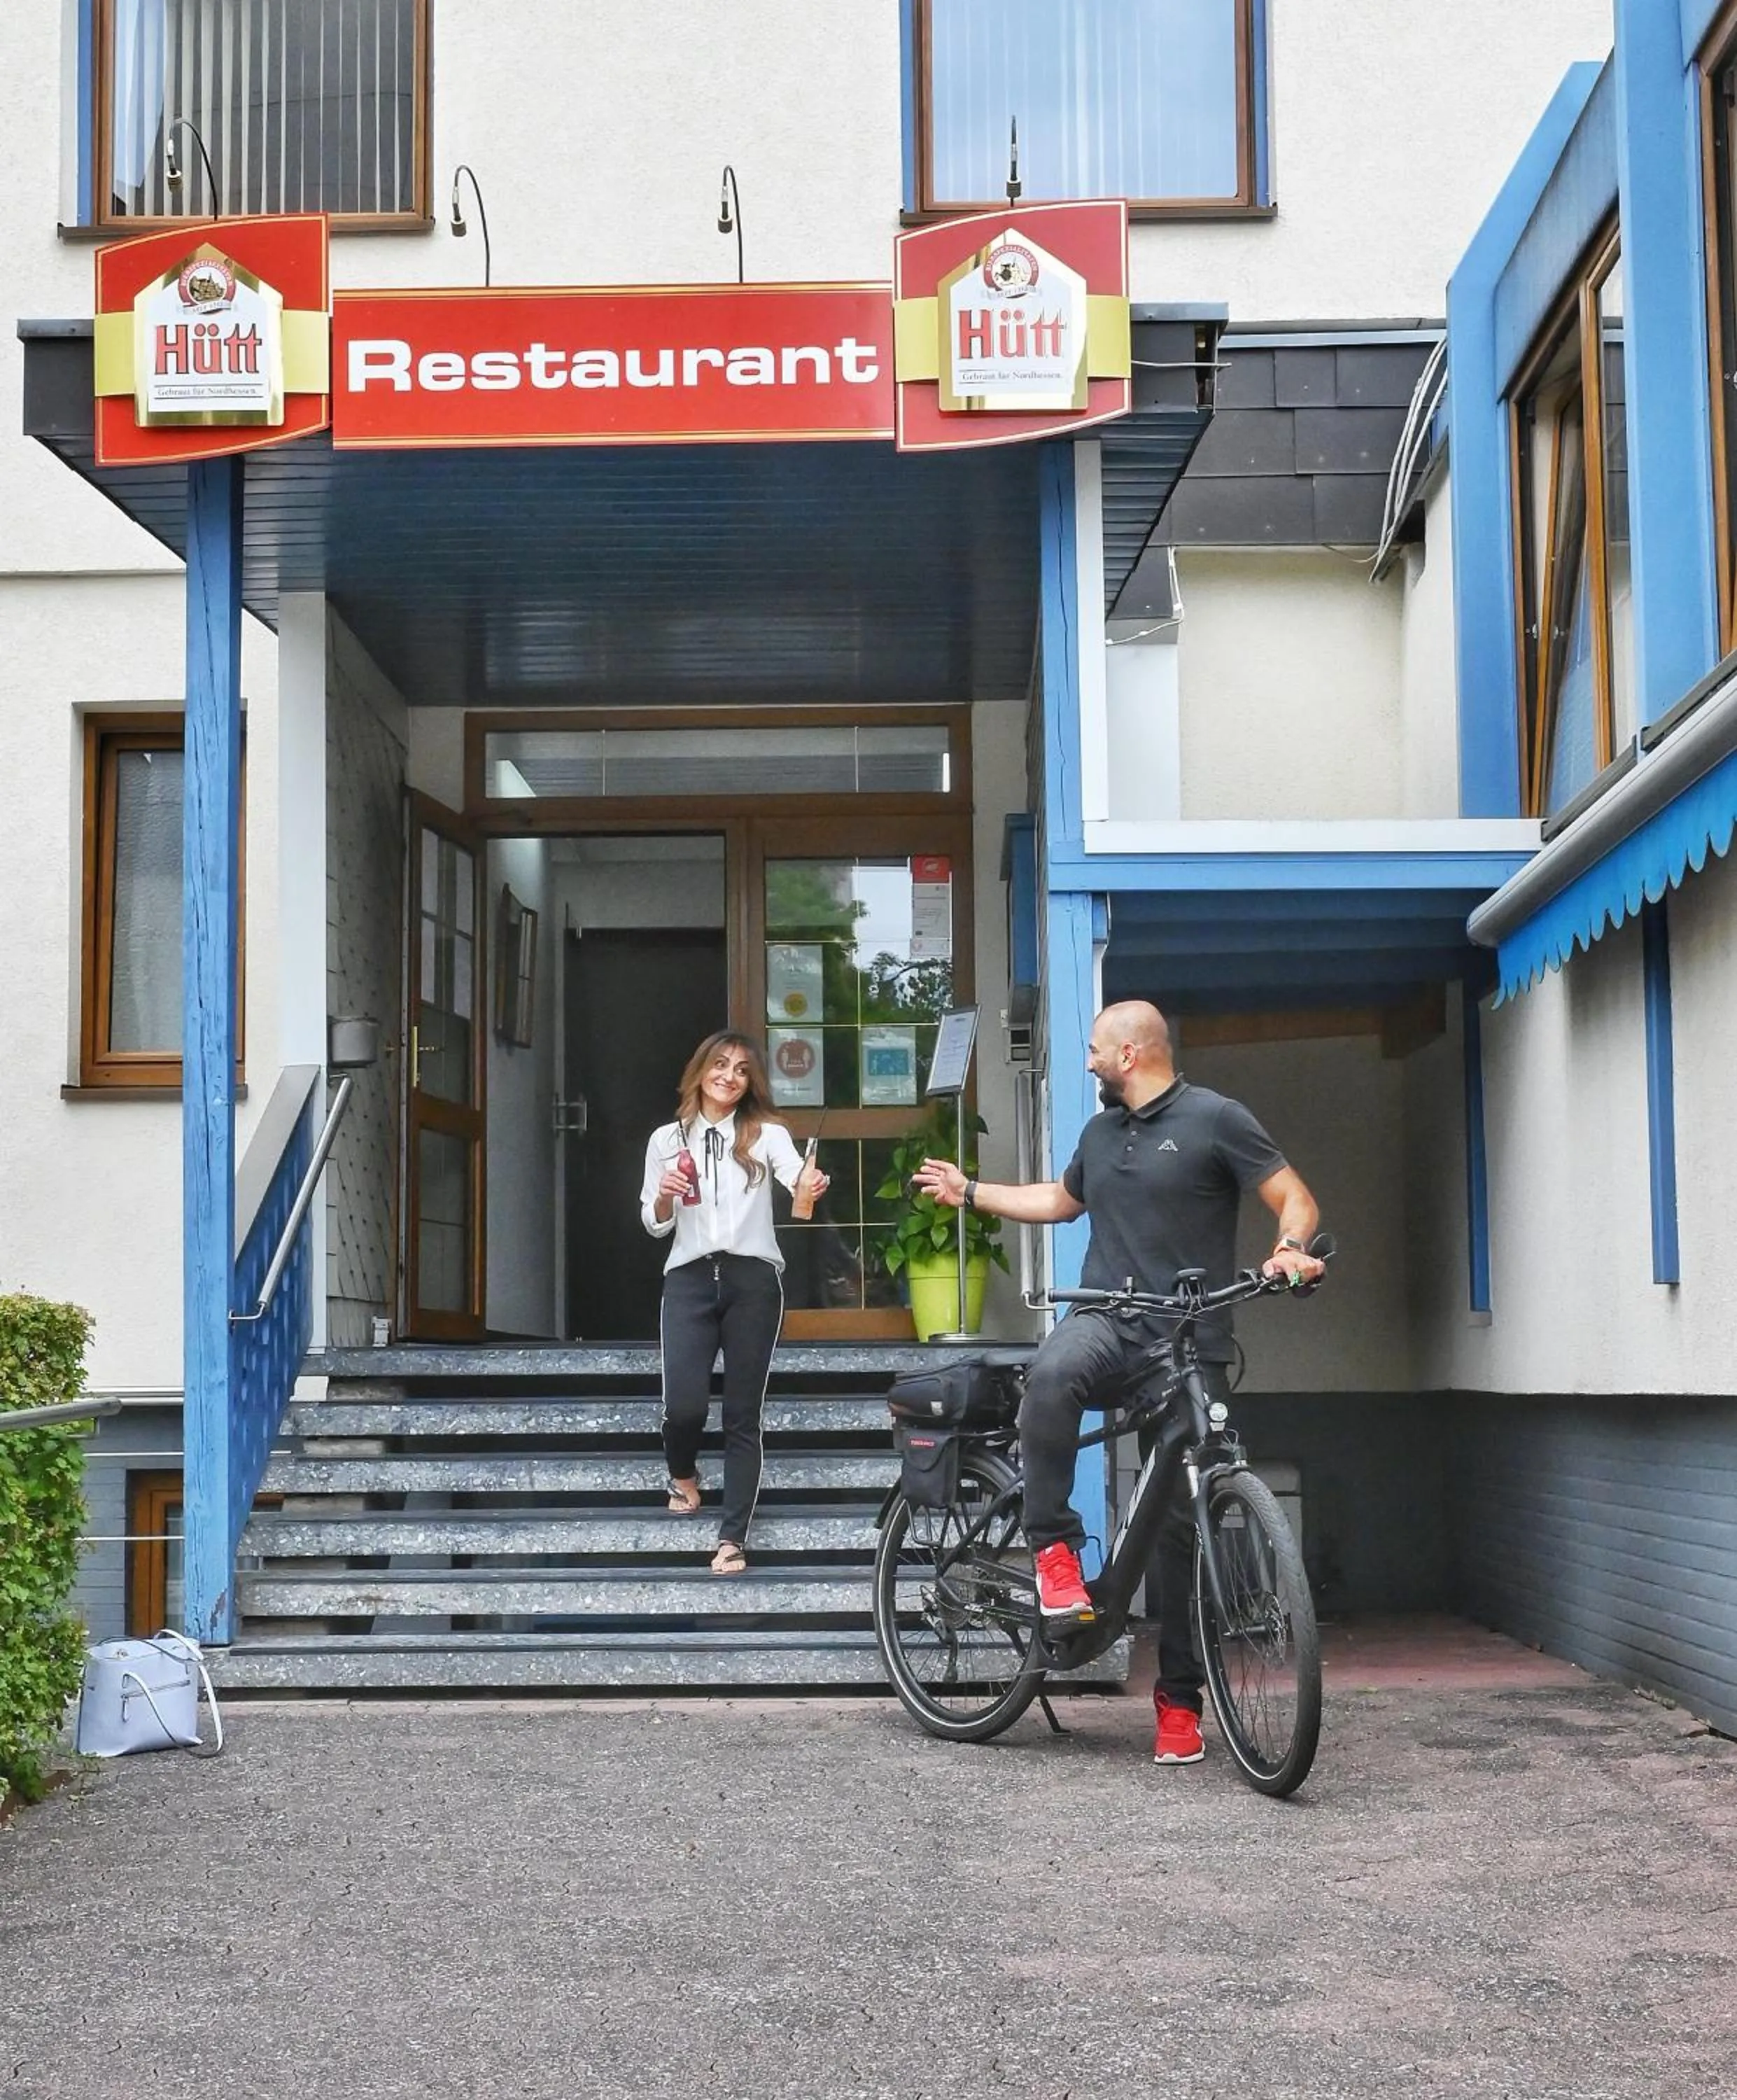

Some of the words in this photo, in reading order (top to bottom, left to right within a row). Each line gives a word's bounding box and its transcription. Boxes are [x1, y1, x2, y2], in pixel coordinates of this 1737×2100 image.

[155, 323, 262, 374] Hütt
[958, 307, 1067, 360] Hütt
[347, 337, 880, 393] Restaurant
